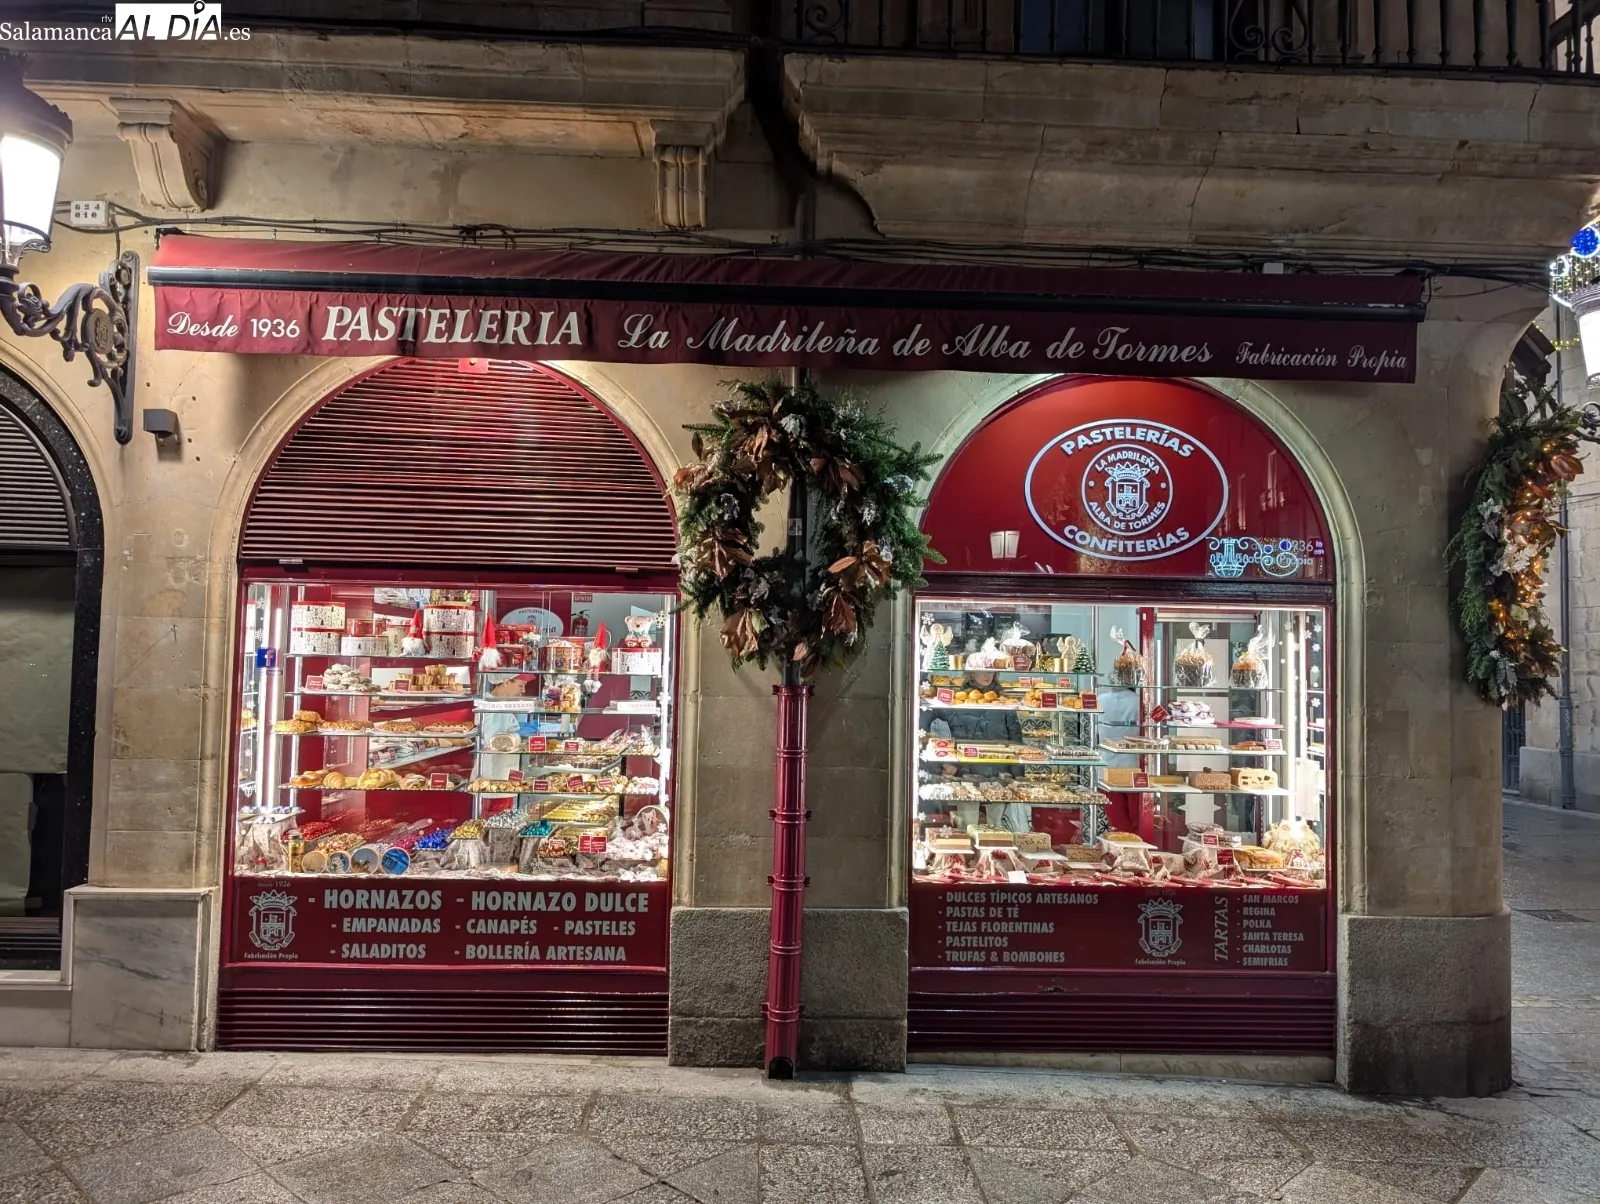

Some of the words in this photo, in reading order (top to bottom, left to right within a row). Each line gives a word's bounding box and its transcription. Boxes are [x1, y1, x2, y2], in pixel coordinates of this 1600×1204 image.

[166, 311, 239, 338] Desde
[250, 318, 300, 339] 1936
[321, 306, 583, 346] PASTELERIA
[618, 313, 670, 349] La
[687, 317, 880, 356] Madrileña
[892, 323, 931, 356] de
[942, 323, 1032, 359] Alba
[1046, 327, 1085, 360] de
[1093, 326, 1213, 363] Tormes
[1235, 341, 1338, 367] Fabricación
[1347, 344, 1407, 376] Propia
[1060, 426, 1195, 458] PASTELERÍAS
[1095, 459, 1108, 472] LA
[1107, 451, 1160, 474] MADRILEÑA
[1089, 502, 1111, 525] ALBA
[1113, 520, 1126, 530] DE
[1128, 501, 1166, 530] TORMES
[1063, 525, 1190, 553] CONFITERÍAS
[324, 889, 443, 910] HORNAZOS
[471, 890, 577, 912] HORNAZO
[585, 892, 649, 913] DULCE
[946, 892, 986, 903] DULCES
[990, 890, 1032, 904] TÍPICOS
[1035, 892, 1099, 905] ARTESANOS
[1243, 895, 1260, 904] SAN
[1263, 895, 1299, 904] MARCOS
[946, 906, 986, 918] PASTAS
[989, 907, 1003, 918] DE
[1007, 904, 1020, 918] TÉ
[1243, 907, 1276, 916] REGINA
[342, 917, 441, 933] EMPANADAS
[466, 916, 538, 935] CANAPÉS
[564, 920, 636, 936] PASTELES
[946, 921, 977, 932] TEJAS
[981, 921, 1055, 933] FLORENTINAS
[1214, 896, 1229, 961] TARTAS
[1243, 919, 1272, 928] POLKA
[945, 936, 1009, 947] PASTELITOS
[1242, 932, 1270, 941] SANTA
[1272, 932, 1304, 942] TERESA
[341, 943, 427, 959] SALADITOS
[465, 941, 541, 960] BOLLERÍA
[545, 945, 627, 961] ARTESANA
[1242, 944, 1292, 954] CHARLOTAS
[945, 950, 986, 962] TRUFAS
[990, 950, 999, 962] &
[1002, 951, 1066, 963] BOMBONES
[1242, 957, 1289, 967] SEMIFRIAS
